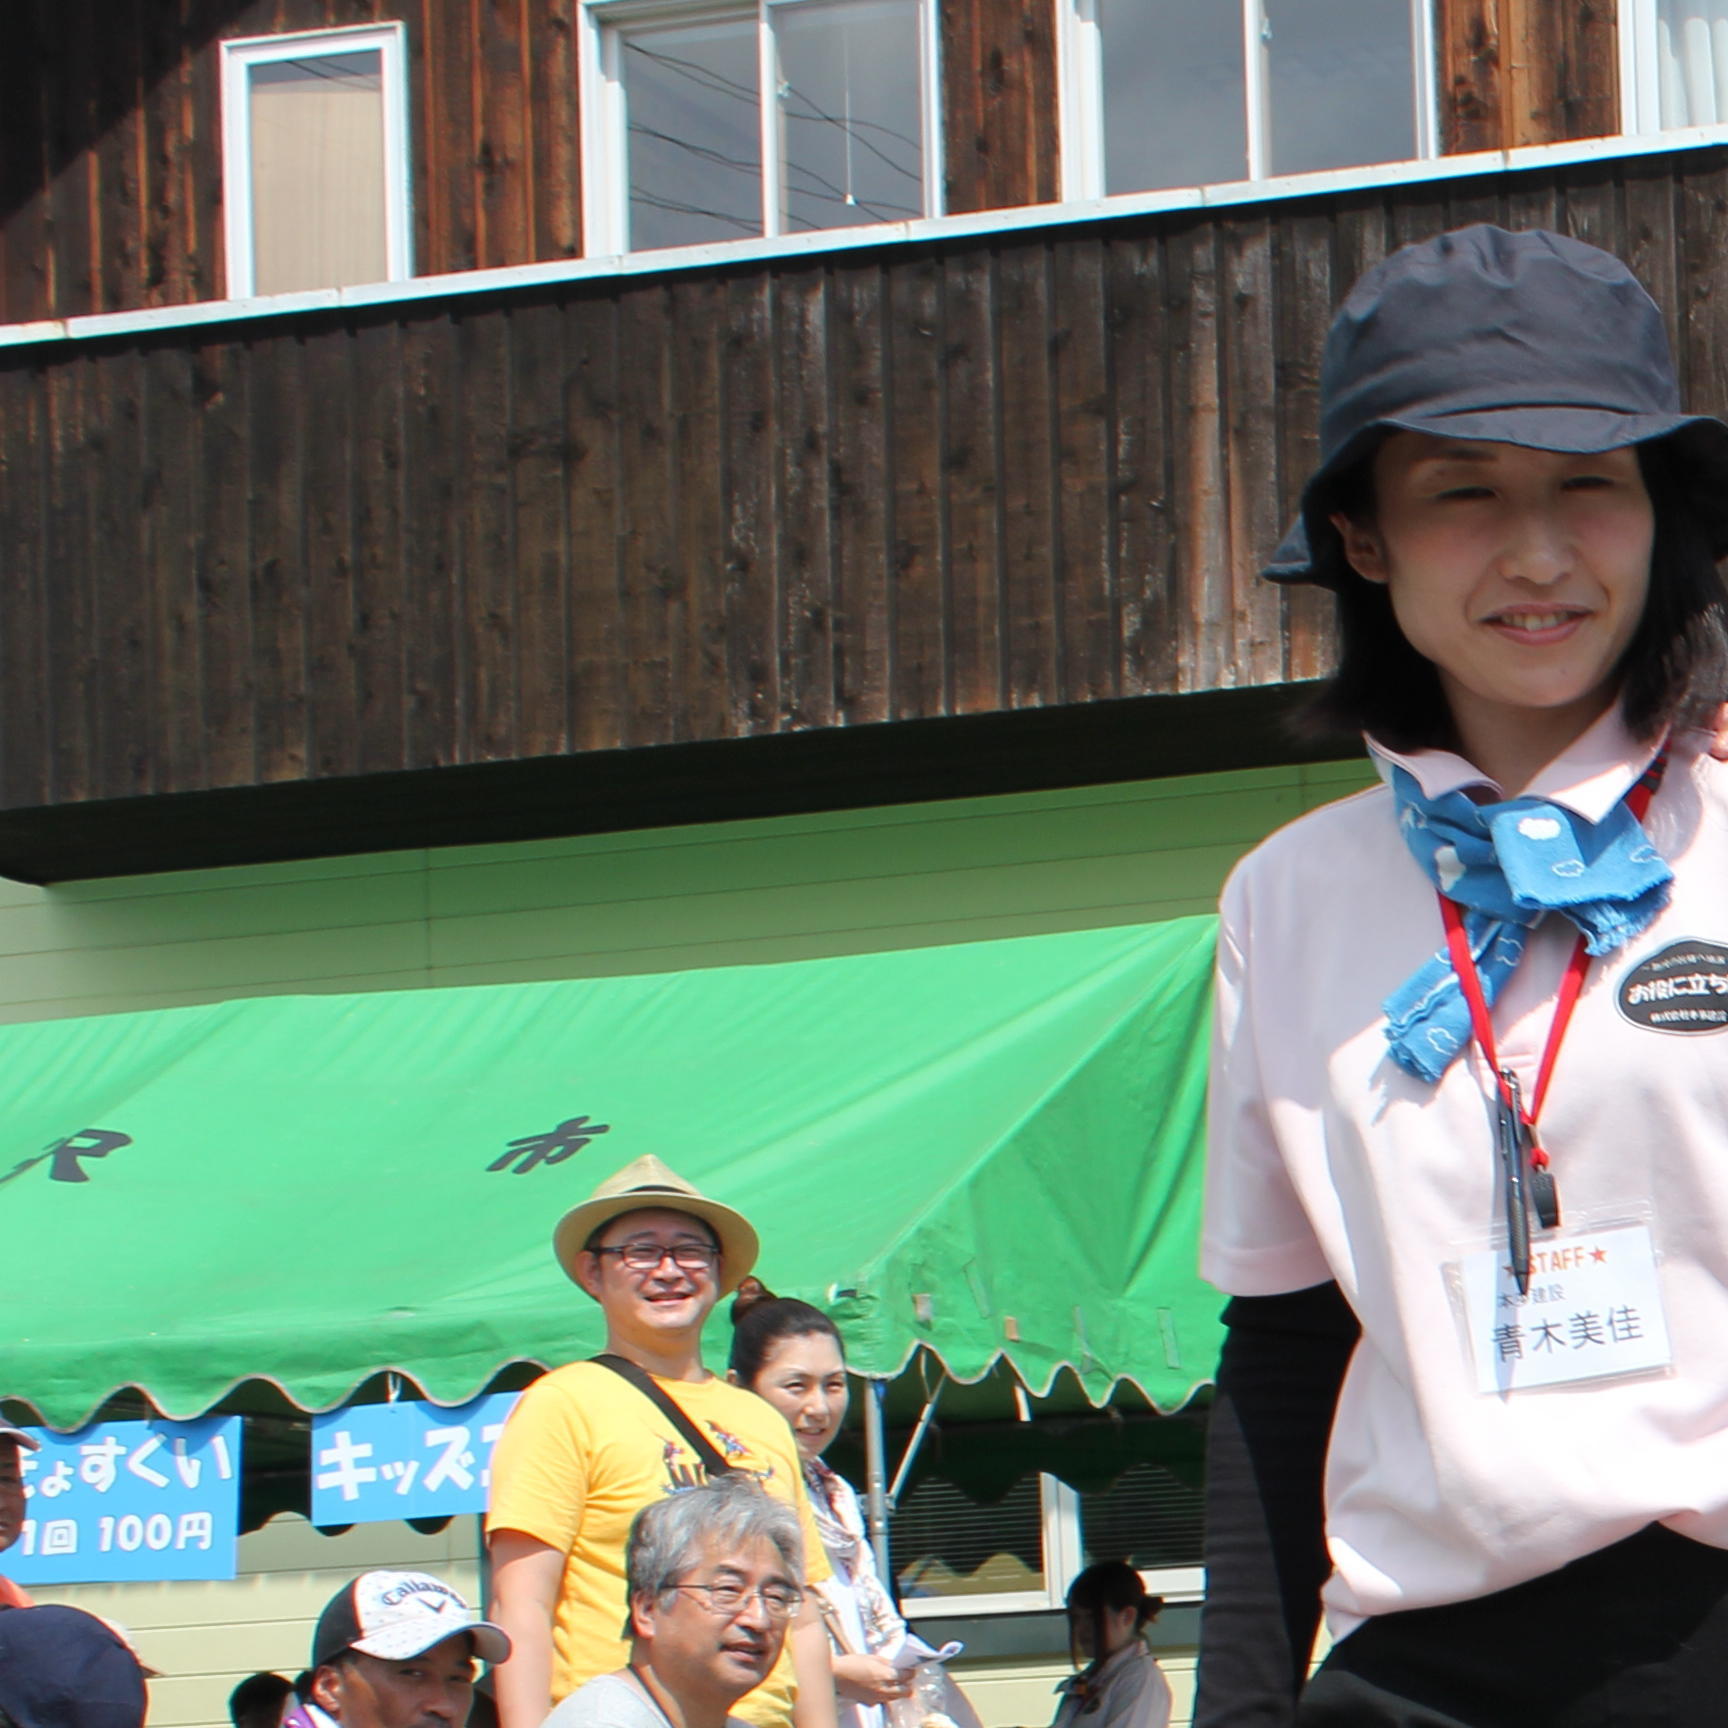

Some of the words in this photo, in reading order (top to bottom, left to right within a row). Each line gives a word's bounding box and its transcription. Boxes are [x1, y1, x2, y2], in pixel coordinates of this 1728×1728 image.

[1527, 1246, 1584, 1275] STAFF
[1491, 1304, 1645, 1363] 青木美佳
[21, 1519, 78, 1556] 1回
[100, 1511, 213, 1552] 100円
